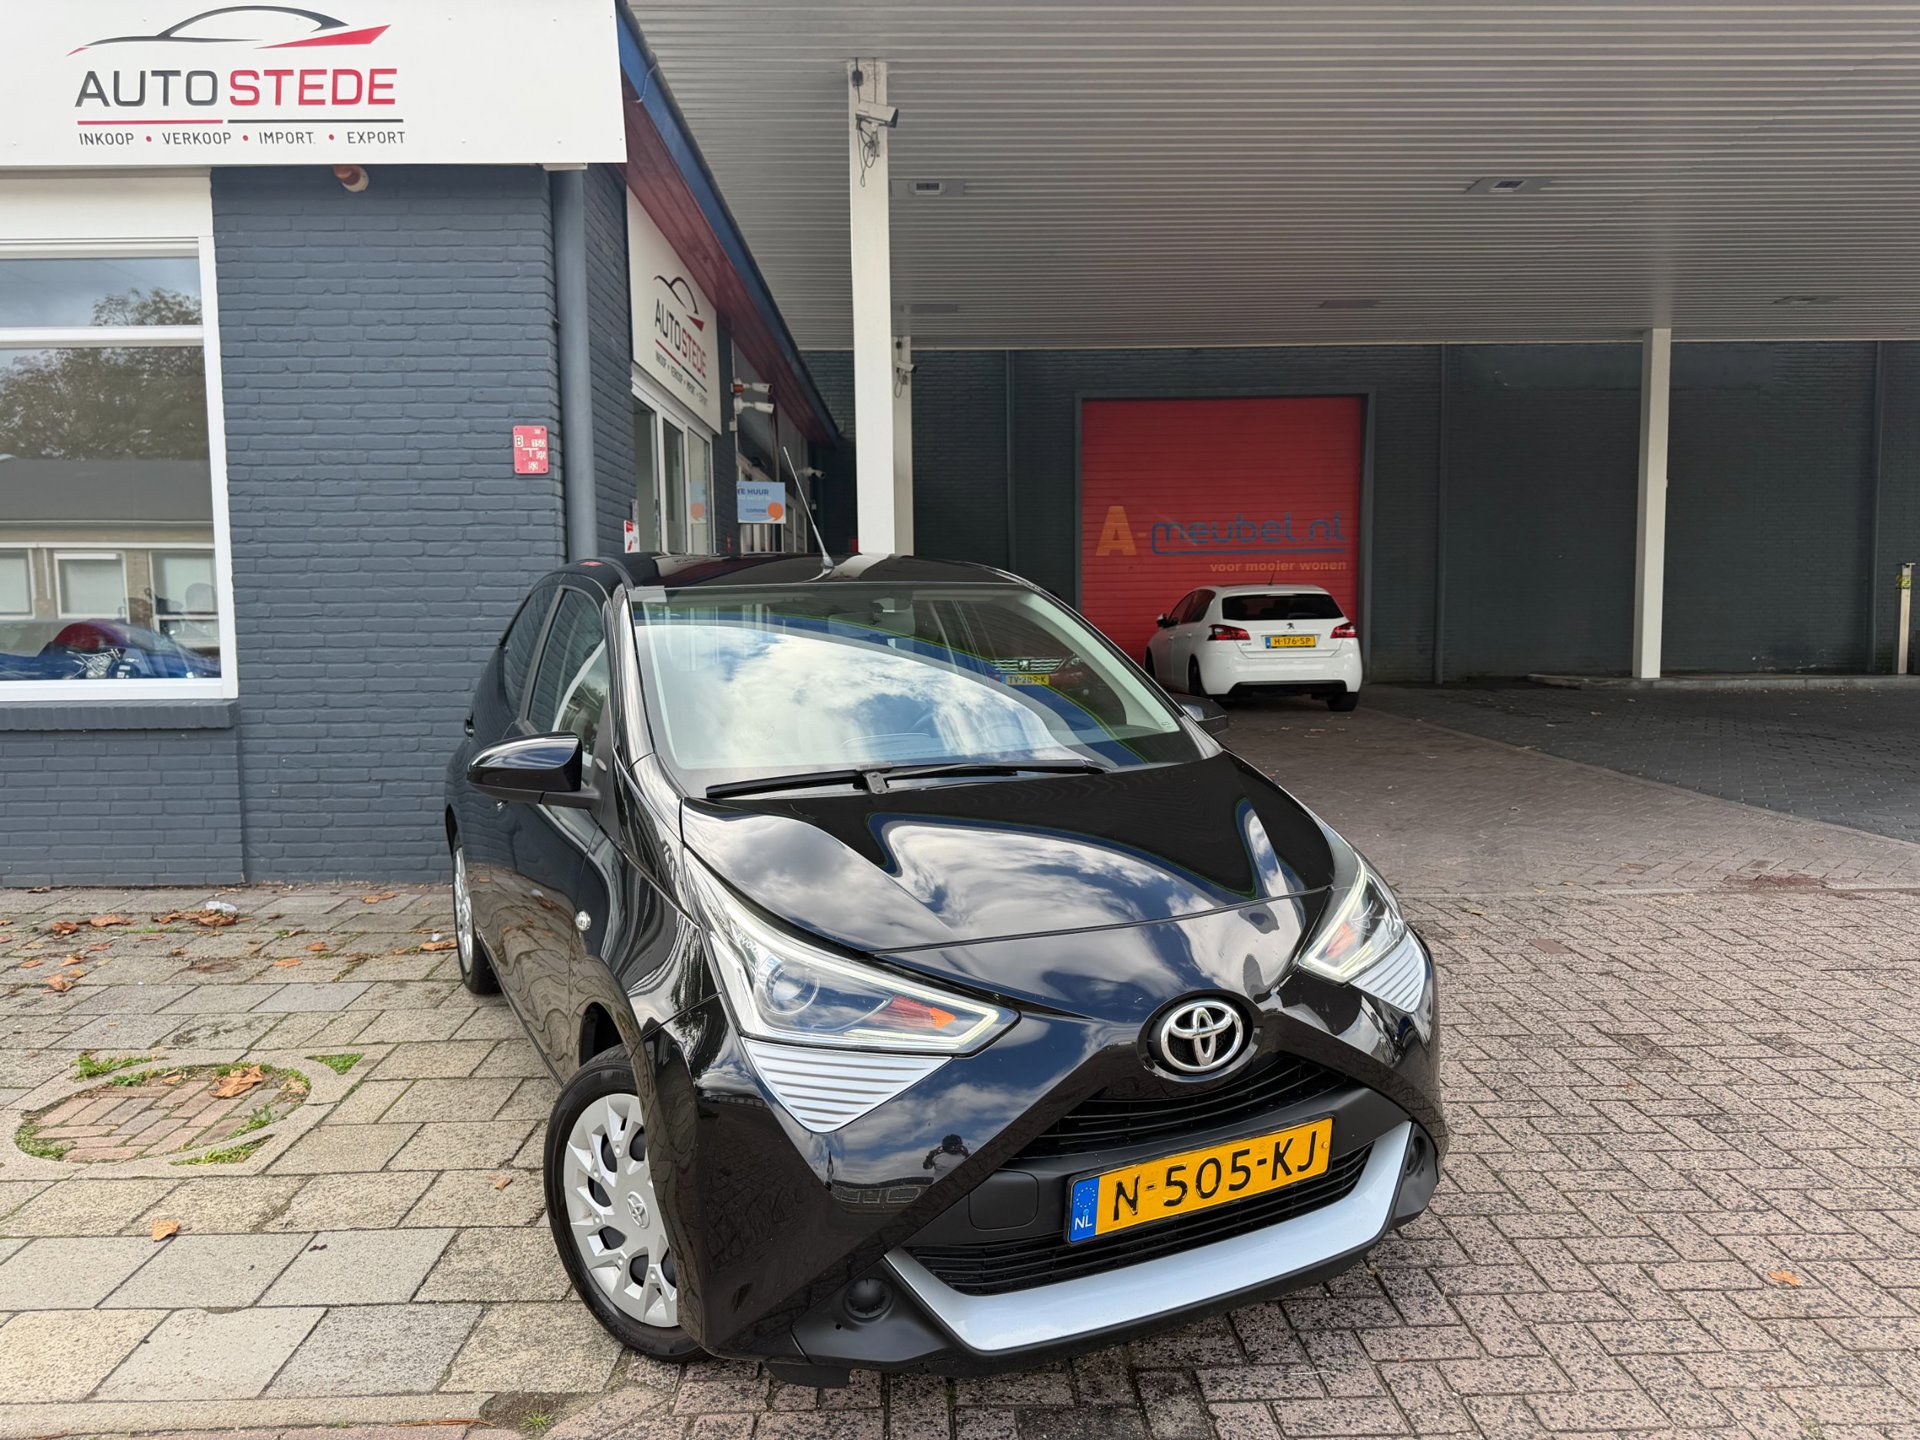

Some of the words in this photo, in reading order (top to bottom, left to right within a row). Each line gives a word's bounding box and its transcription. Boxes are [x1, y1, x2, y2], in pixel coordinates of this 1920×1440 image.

[78, 132, 135, 146] INKOOP
[161, 131, 232, 145] VERKOOP
[258, 131, 314, 145] IMPORT
[346, 130, 406, 144] EXPORT
[1210, 562, 1241, 572] voor
[1245, 560, 1295, 572] mooier
[1299, 560, 1347, 571] wonen
[1273, 637, 1312, 646] H-176-SP
[1112, 1130, 1318, 1222] N-505-KJ
[1073, 1216, 1093, 1231] NL
